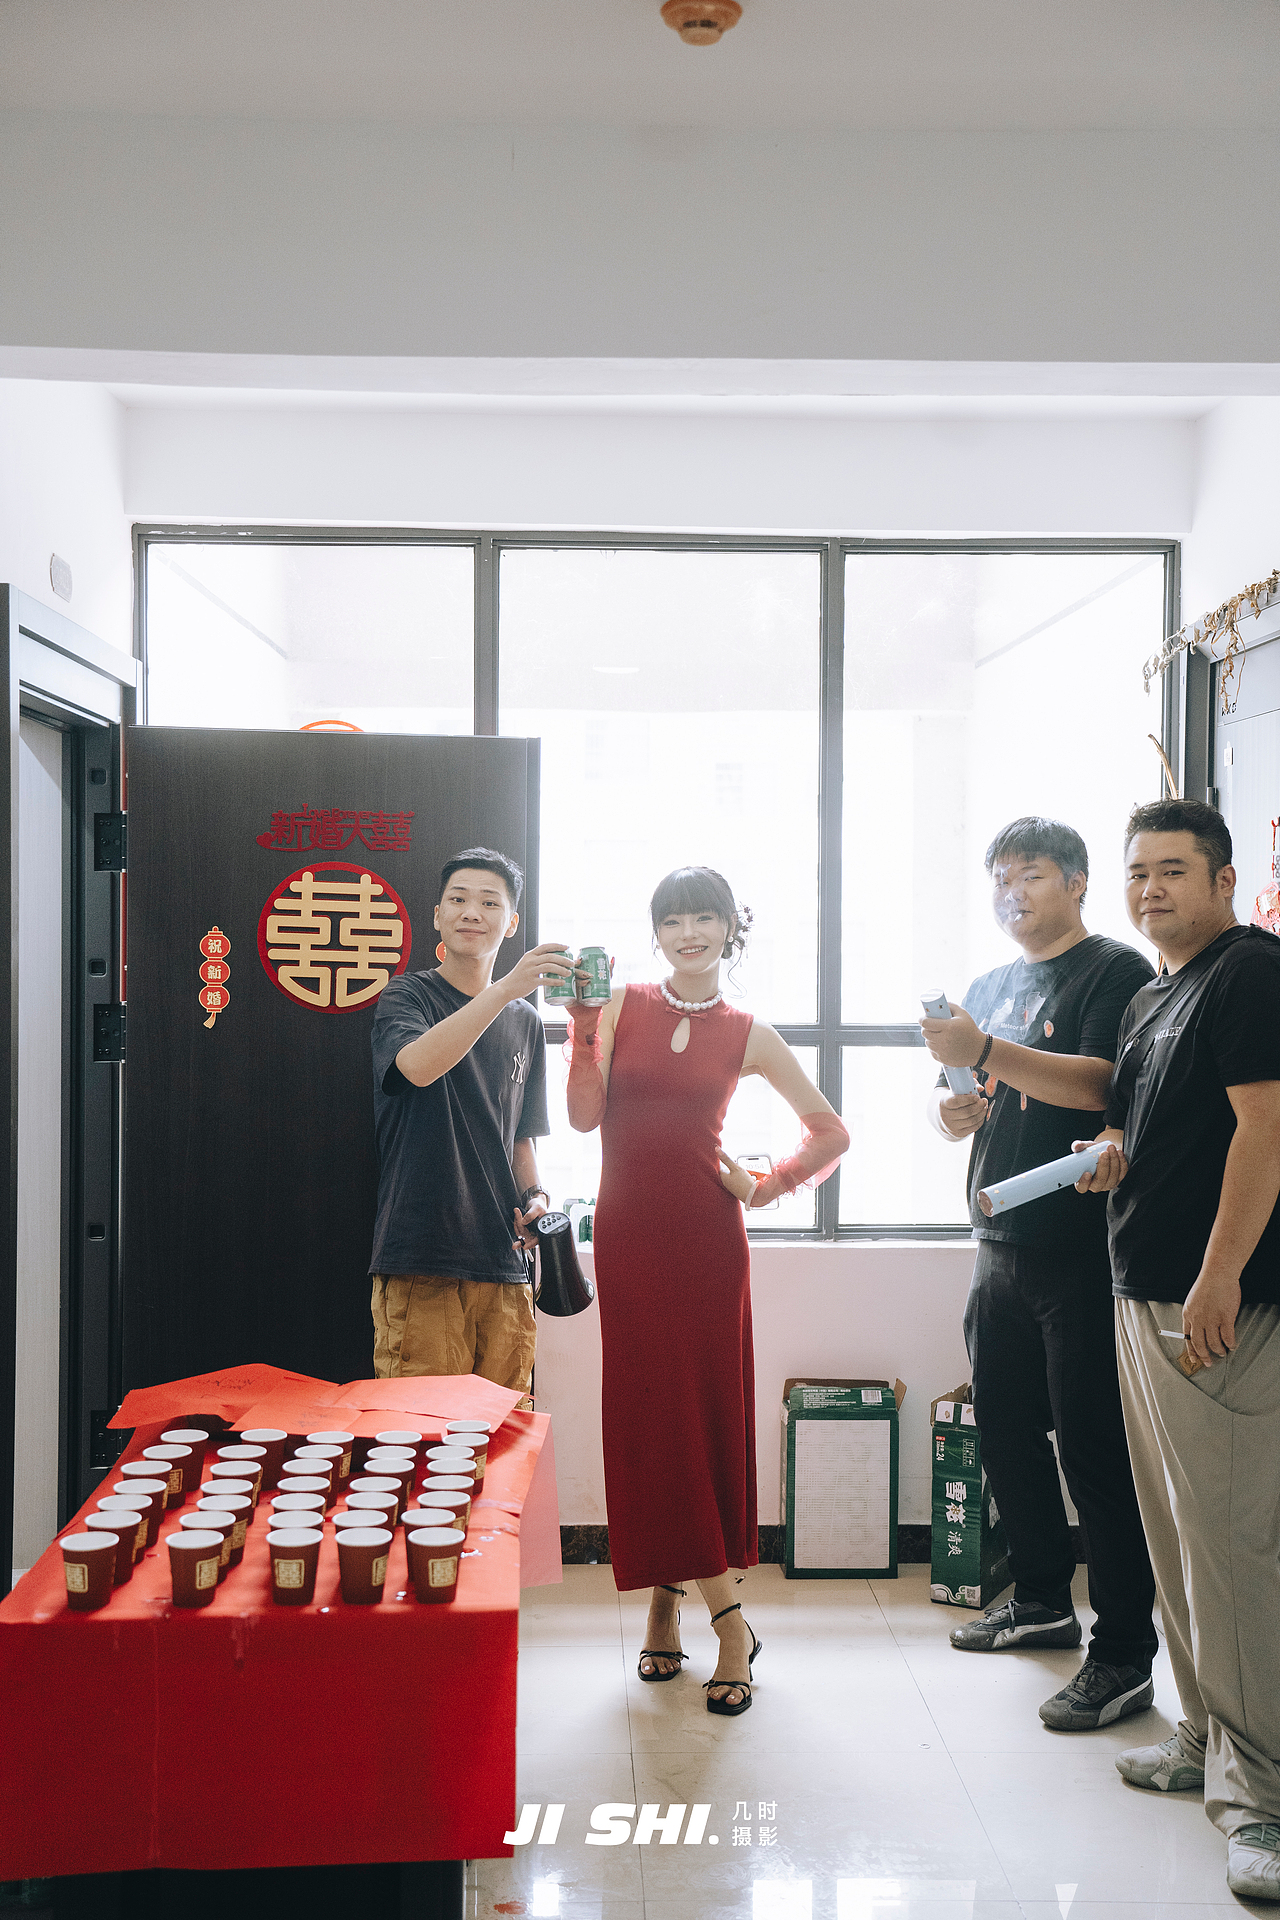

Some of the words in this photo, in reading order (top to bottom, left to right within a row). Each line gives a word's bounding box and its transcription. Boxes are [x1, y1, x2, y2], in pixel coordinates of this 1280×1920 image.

[302, 803, 330, 819] Love
[207, 938, 222, 1006] 祝新婚
[510, 1051, 526, 1085] NY
[945, 1481, 967, 1524] 雪花
[947, 1530, 963, 1557] 清爽
